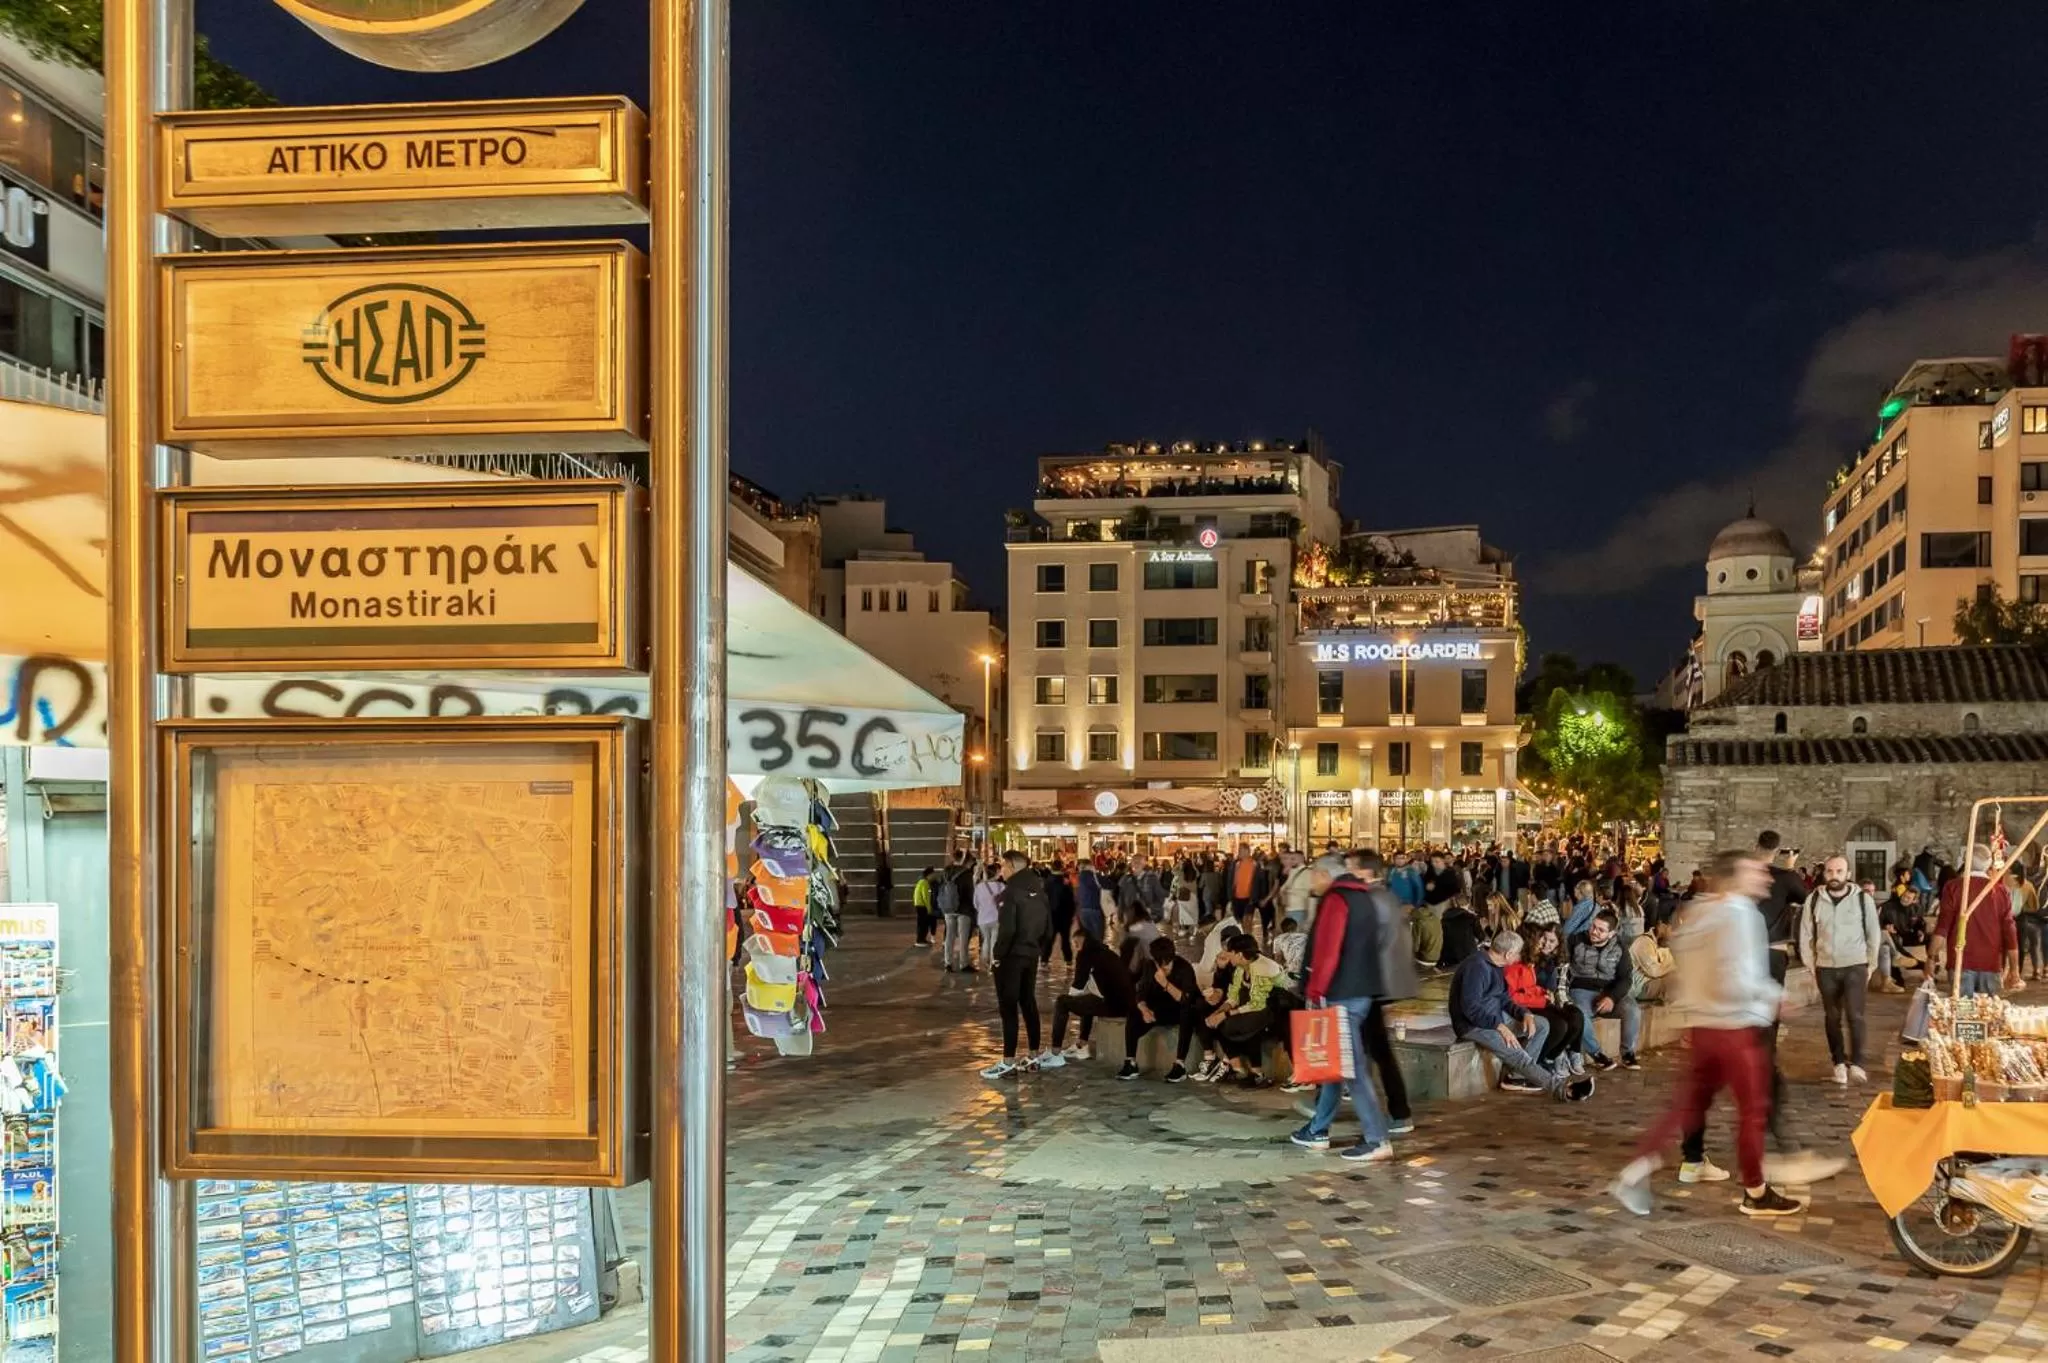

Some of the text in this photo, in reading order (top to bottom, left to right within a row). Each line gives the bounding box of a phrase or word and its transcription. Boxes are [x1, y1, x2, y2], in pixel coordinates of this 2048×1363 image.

[267, 136, 527, 174] ΑΤΤΙΚΟ ΜΕΤΡΟ
[334, 298, 453, 386] ΗΣΑΠ
[290, 588, 497, 619] Monastiraki
[1408, 643, 1481, 660] GARDEN
